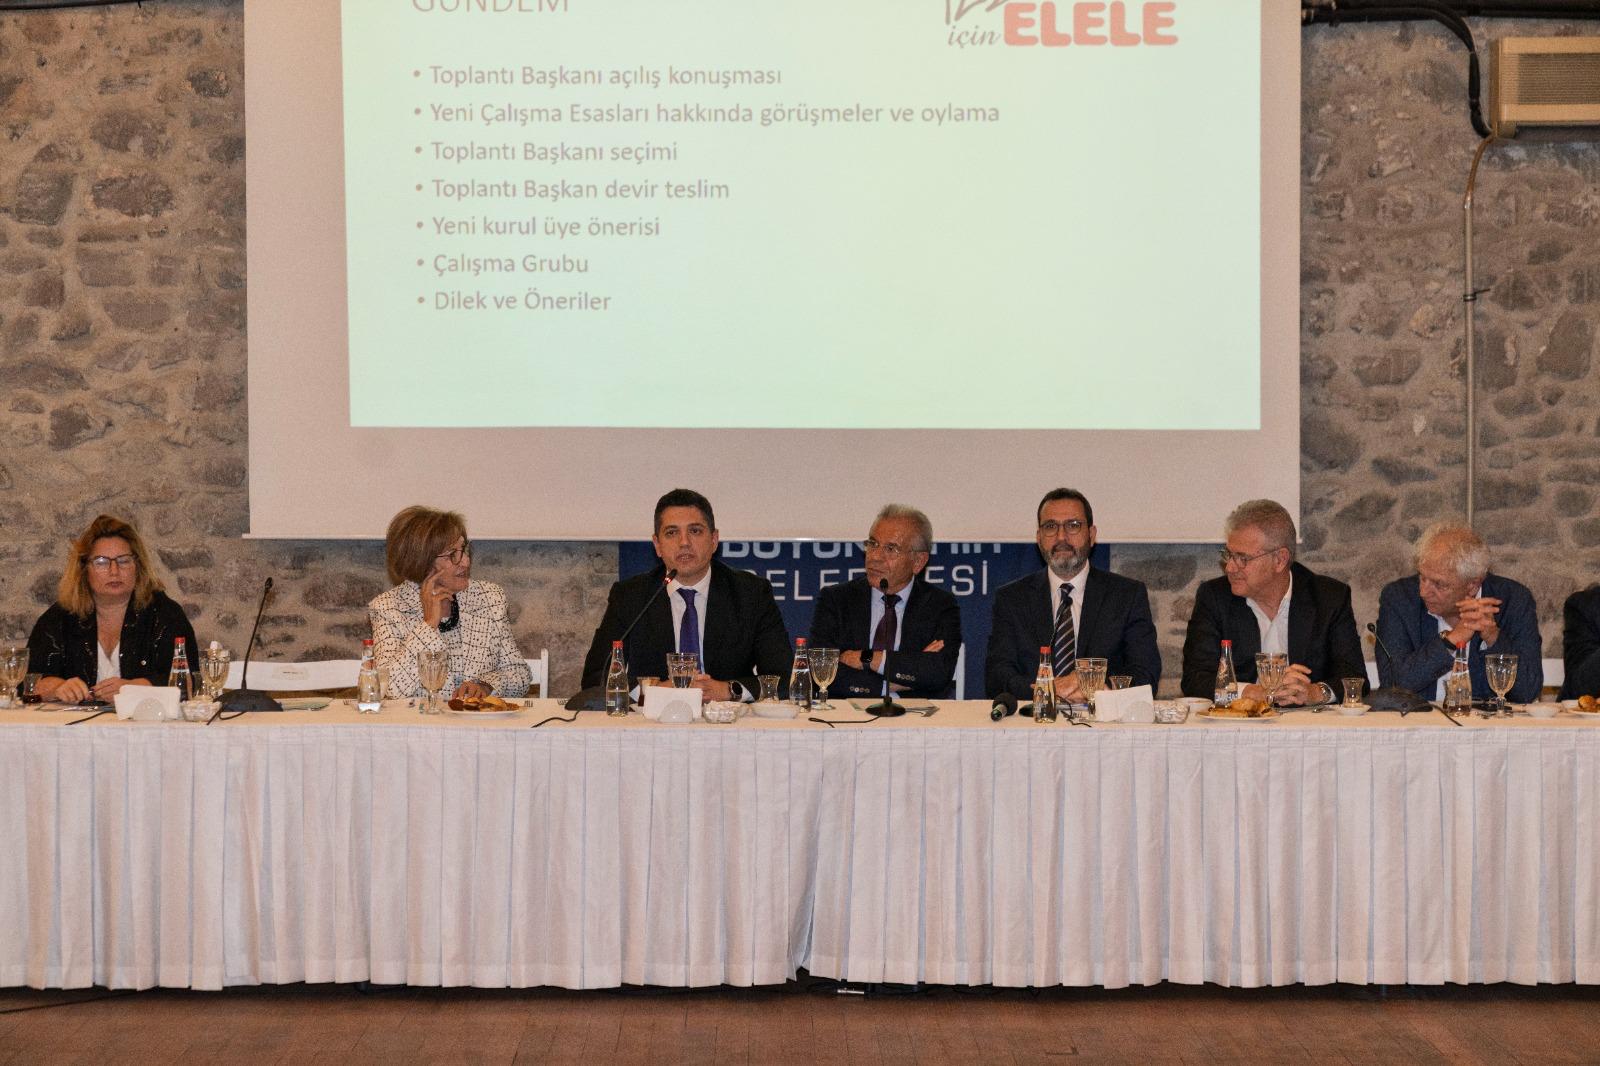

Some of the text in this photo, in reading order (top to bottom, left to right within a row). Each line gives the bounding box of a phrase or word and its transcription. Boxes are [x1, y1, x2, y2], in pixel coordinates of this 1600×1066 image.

[947, 1, 1179, 49] için ELELE
[429, 65, 781, 89] Toplantı Başkanı açılış konuşması
[430, 103, 999, 127] Yeni Çalışma Esasları hakkında görüşmeler ve oylama
[431, 141, 677, 165] Toplantı Başkanı seçimi
[432, 179, 729, 202] Toplantı Başkan devir teslim
[432, 216, 659, 239] Yeni kurul üye önerisi
[434, 253, 588, 277] Çalışma Grubu
[435, 288, 611, 310] Dilek ve Öneriler
